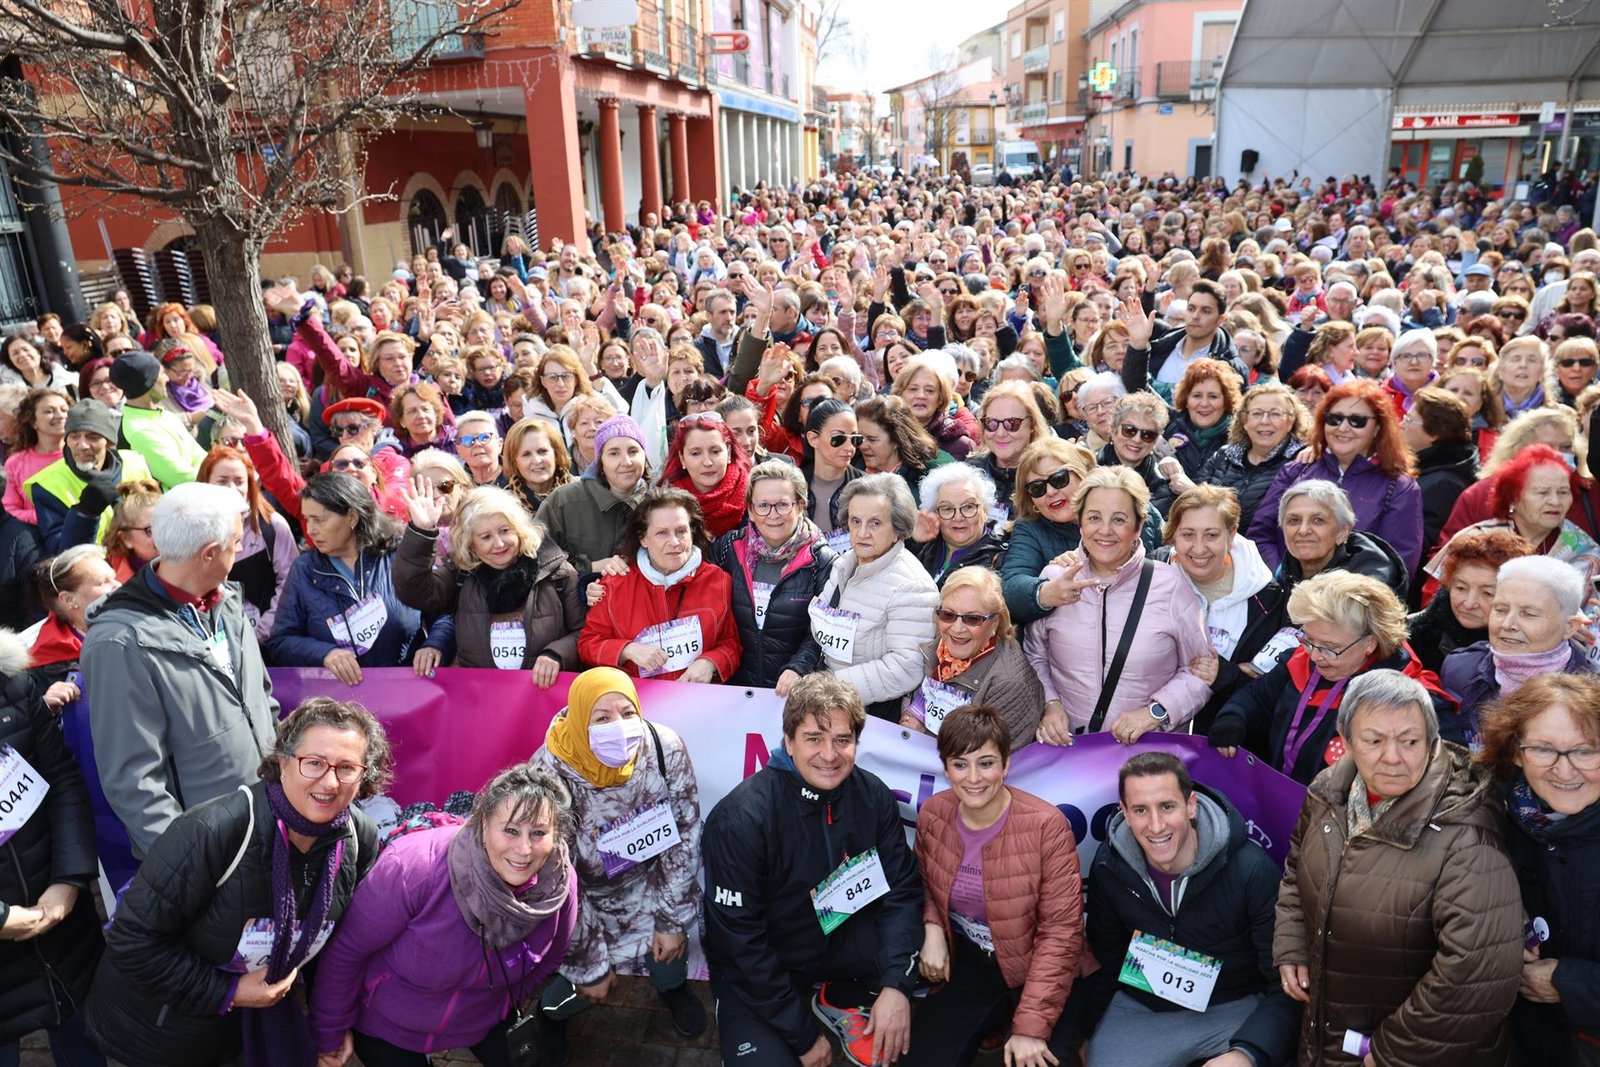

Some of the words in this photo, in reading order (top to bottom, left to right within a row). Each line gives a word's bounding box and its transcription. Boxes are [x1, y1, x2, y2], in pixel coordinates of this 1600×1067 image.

[666, 640, 699, 658] 5415
[816, 630, 849, 650] 05417
[0, 773, 34, 820] 0441
[627, 824, 672, 855] 02075
[846, 877, 872, 901] 842
[1162, 971, 1195, 993] 013
